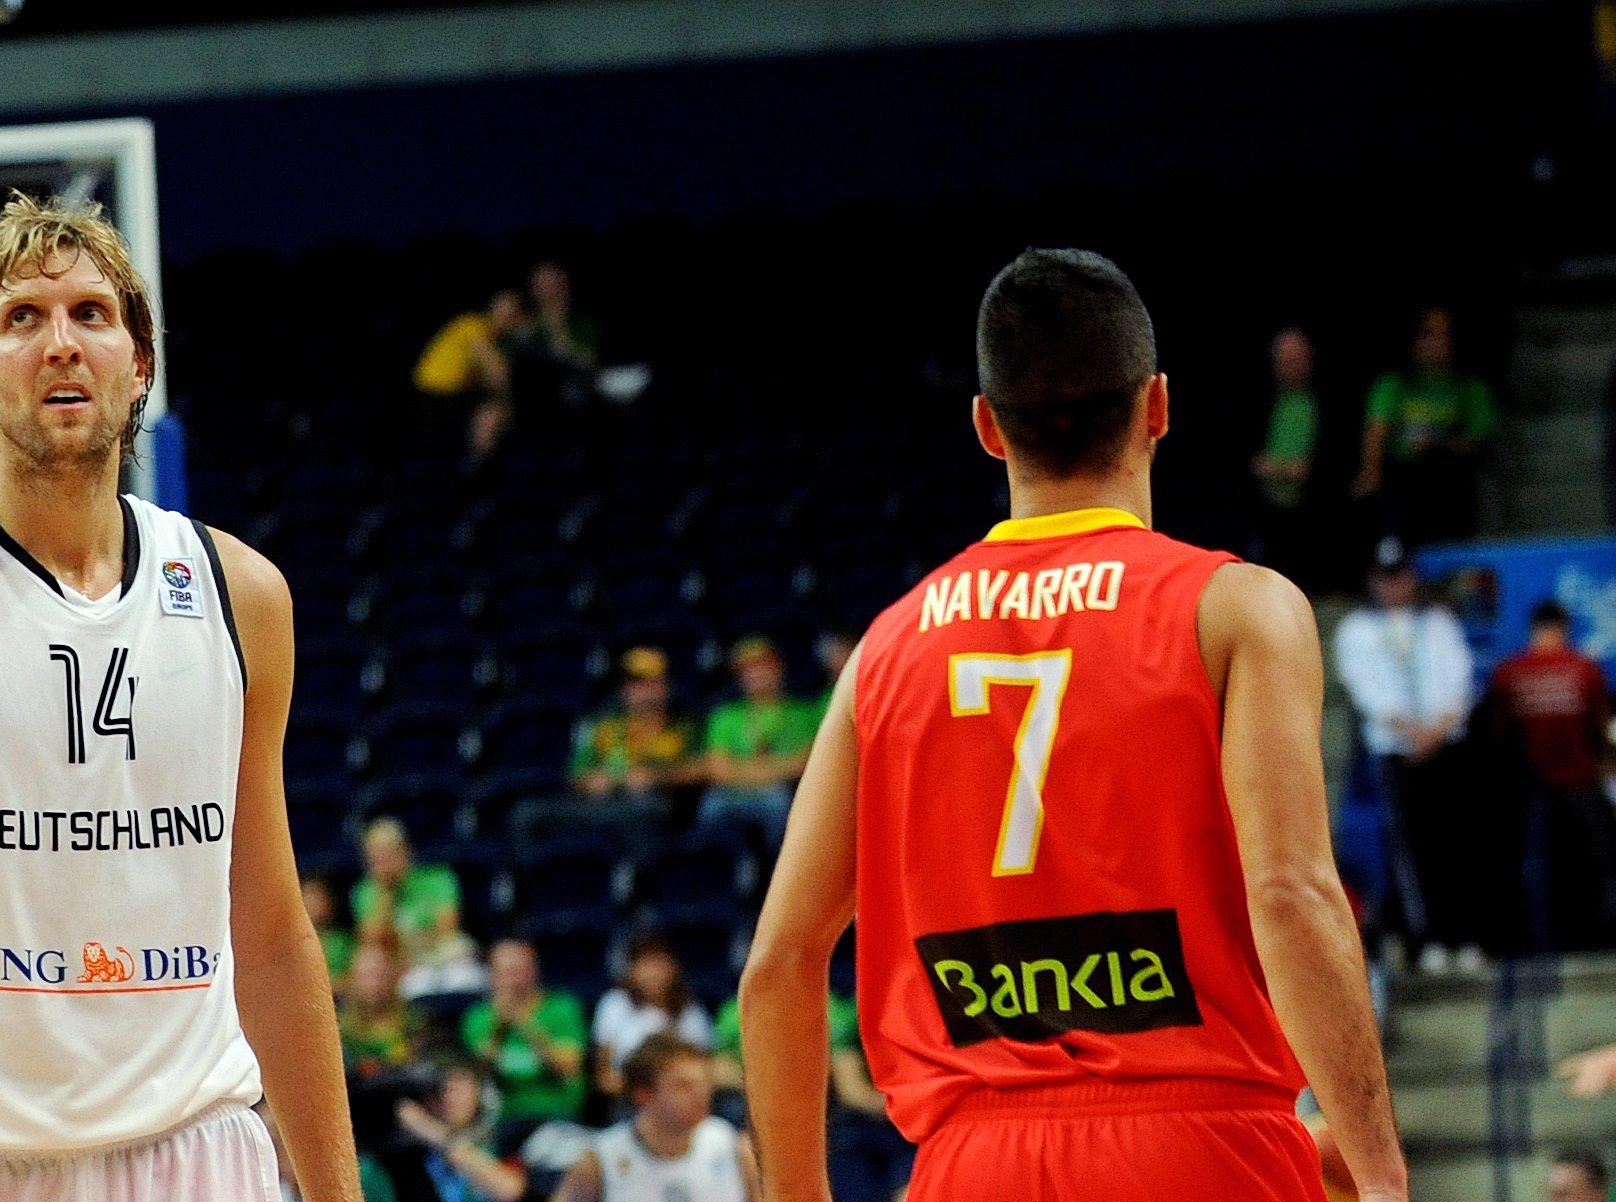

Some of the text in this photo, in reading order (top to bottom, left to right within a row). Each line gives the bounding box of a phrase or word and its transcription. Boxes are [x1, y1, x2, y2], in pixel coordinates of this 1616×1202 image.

[169, 590, 192, 602] FIBA
[918, 561, 1125, 632] NAVARRO
[49, 644, 139, 764] 14
[947, 648, 1072, 877] 7
[934, 948, 1175, 1018] Bankia
